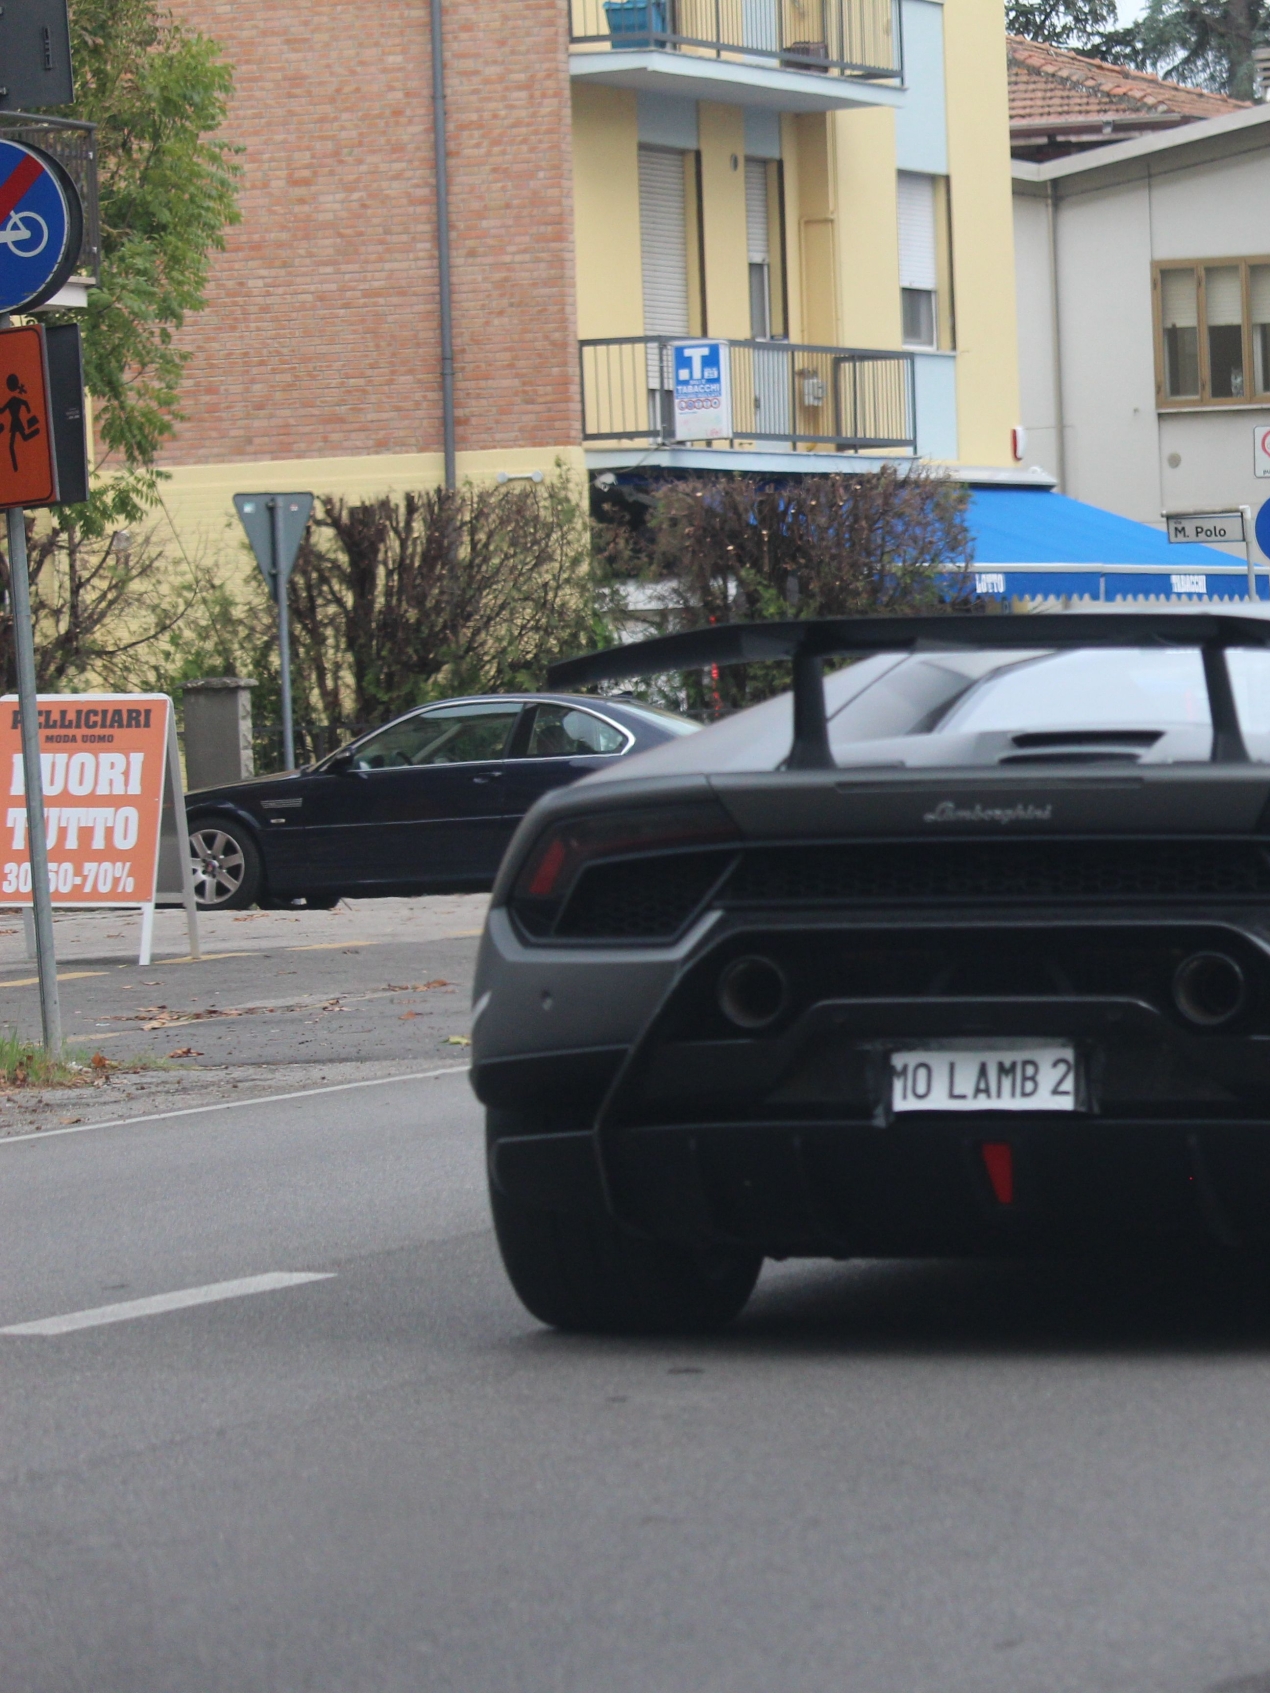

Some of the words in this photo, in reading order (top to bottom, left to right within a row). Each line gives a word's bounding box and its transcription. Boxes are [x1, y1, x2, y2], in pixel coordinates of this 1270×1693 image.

[676, 384, 720, 394] TABACCHI
[1174, 526, 1190, 538] M.
[1195, 525, 1227, 538] Polo
[975, 573, 1006, 594] LOTTO
[45, 734, 77, 744] MODA
[81, 733, 114, 744] UOMO
[923, 801, 1052, 825] Lamborghini
[893, 1062, 932, 1101] MO
[948, 1060, 1040, 1101] LAMB
[1051, 1057, 1072, 1096] 2
